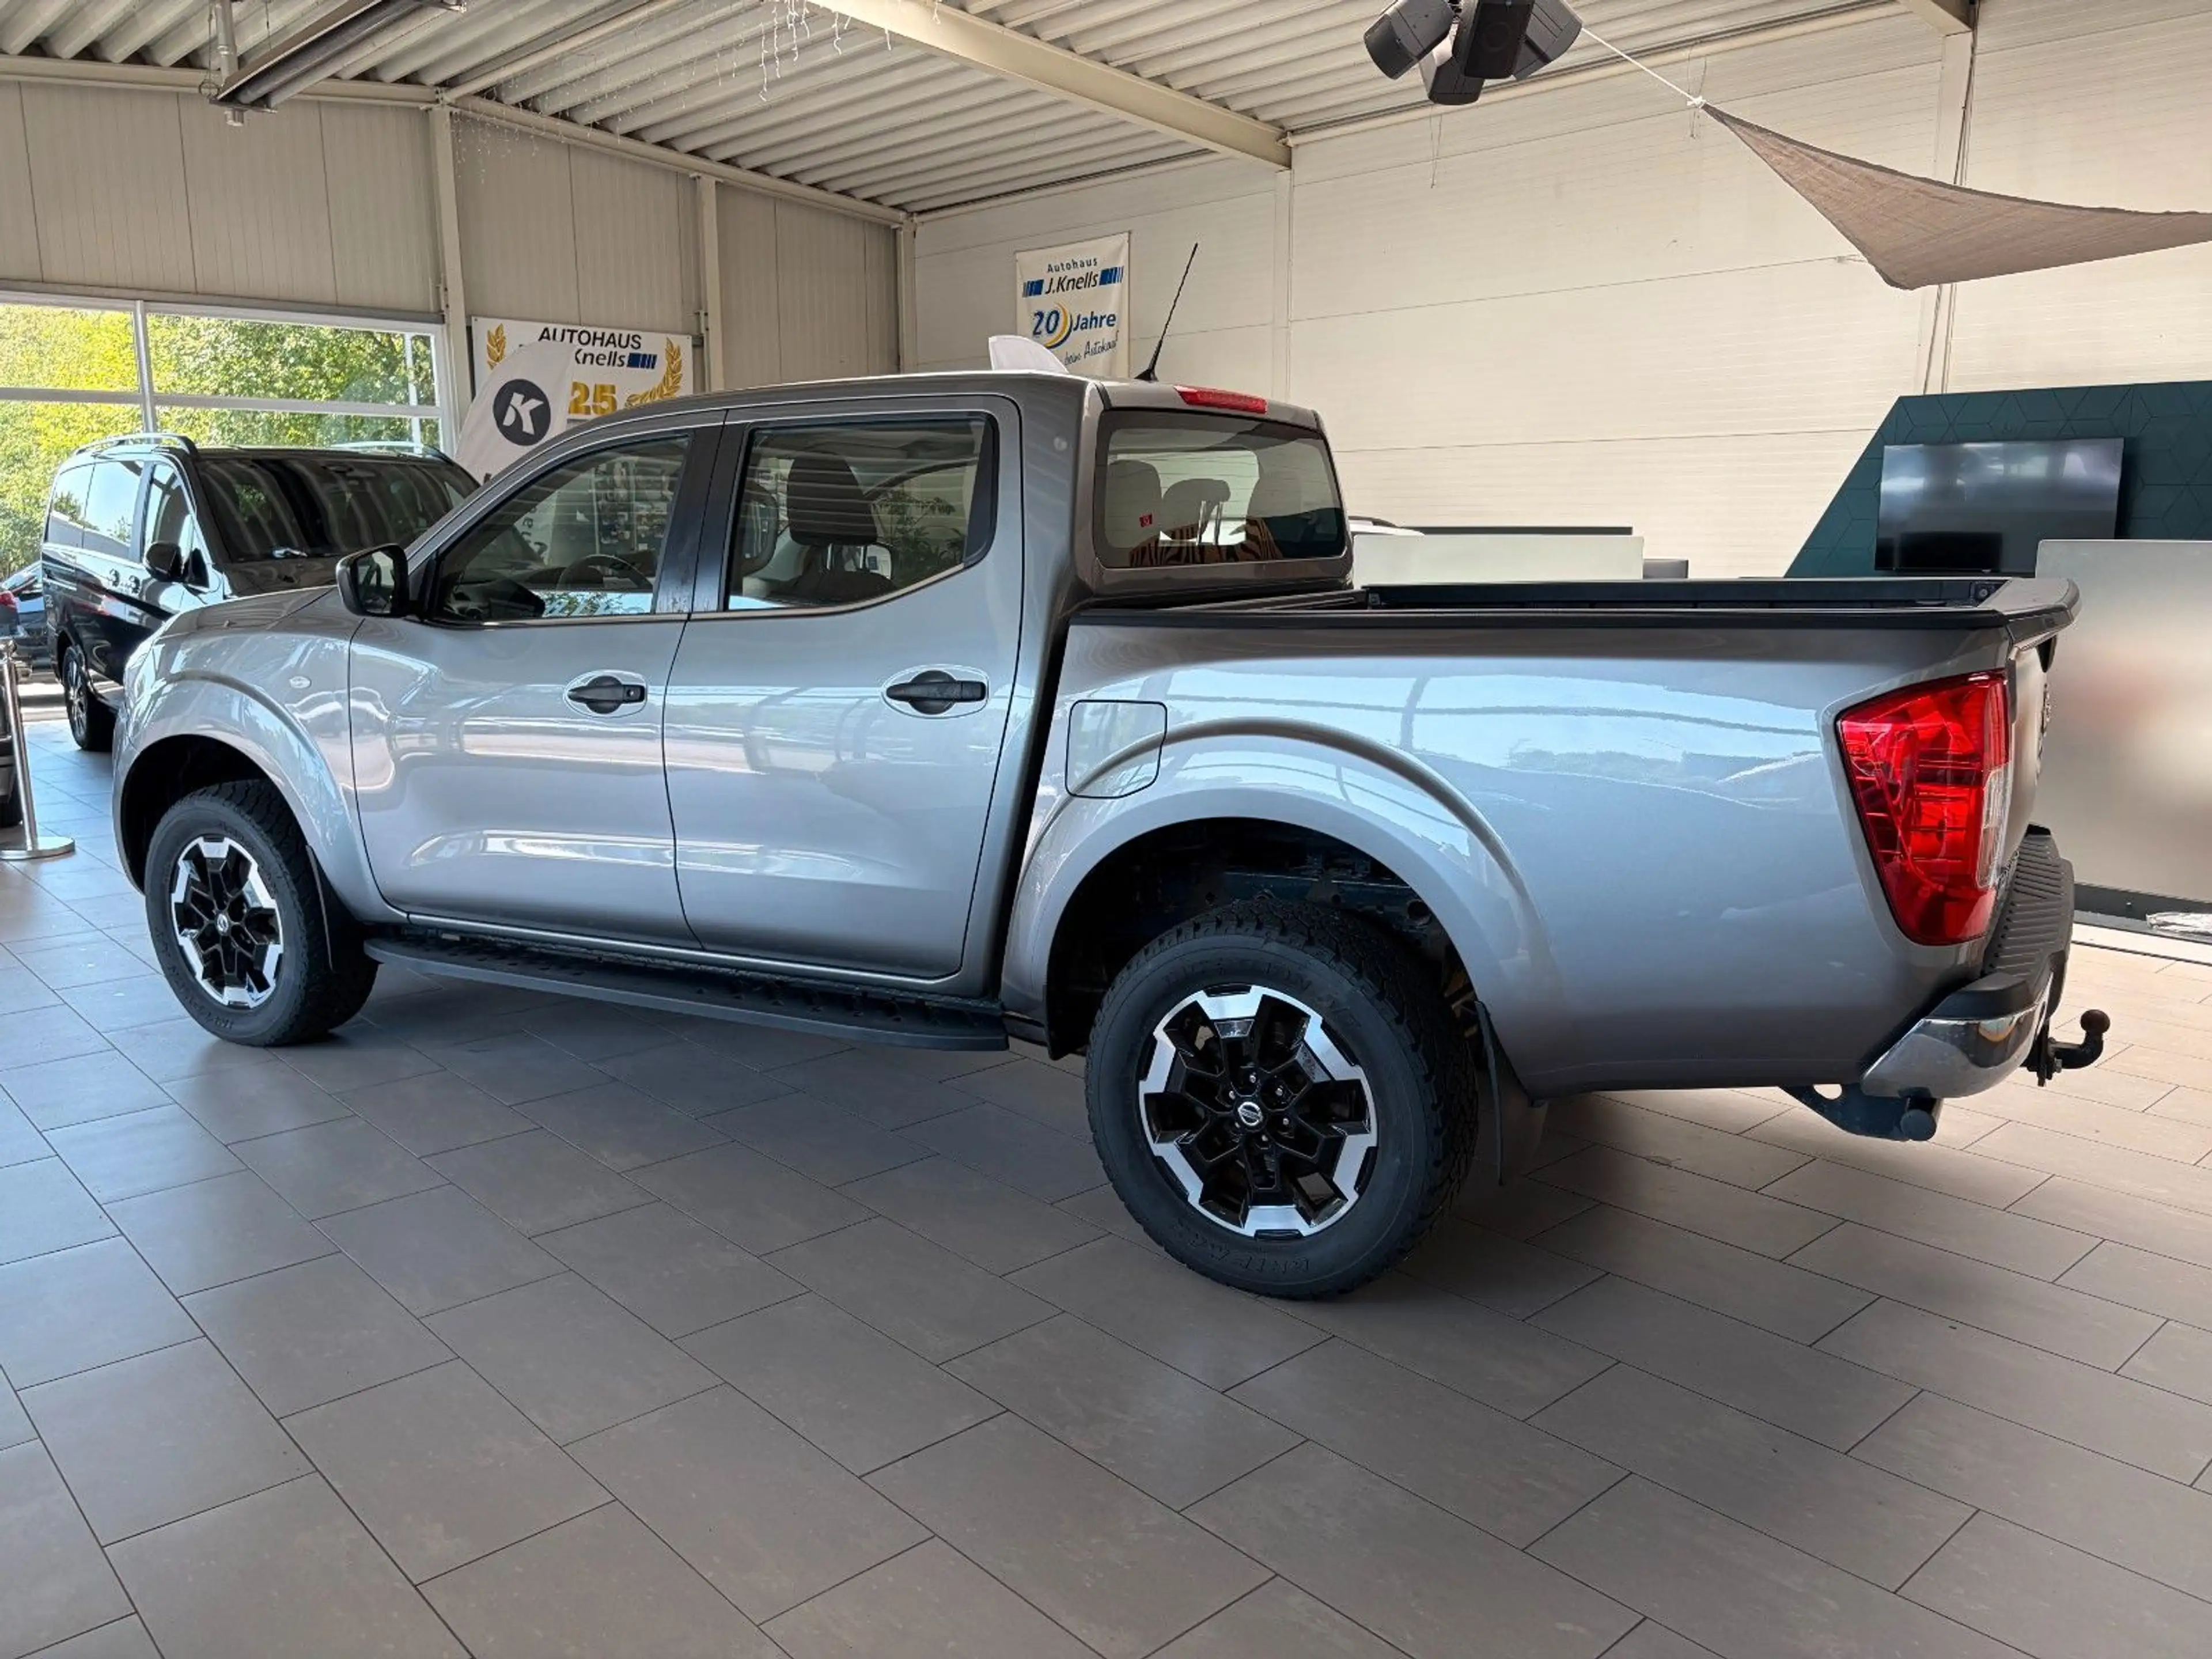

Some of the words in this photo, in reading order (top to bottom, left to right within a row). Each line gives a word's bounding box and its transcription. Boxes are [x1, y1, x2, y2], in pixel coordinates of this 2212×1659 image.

[1047, 258, 1098, 273] Autohaus
[1045, 271, 1099, 296] J.Knells
[1032, 309, 1060, 336] 20
[1073, 310, 1116, 332] Jahre
[538, 327, 642, 350] AUTOHAUS
[568, 381, 618, 415] 25
